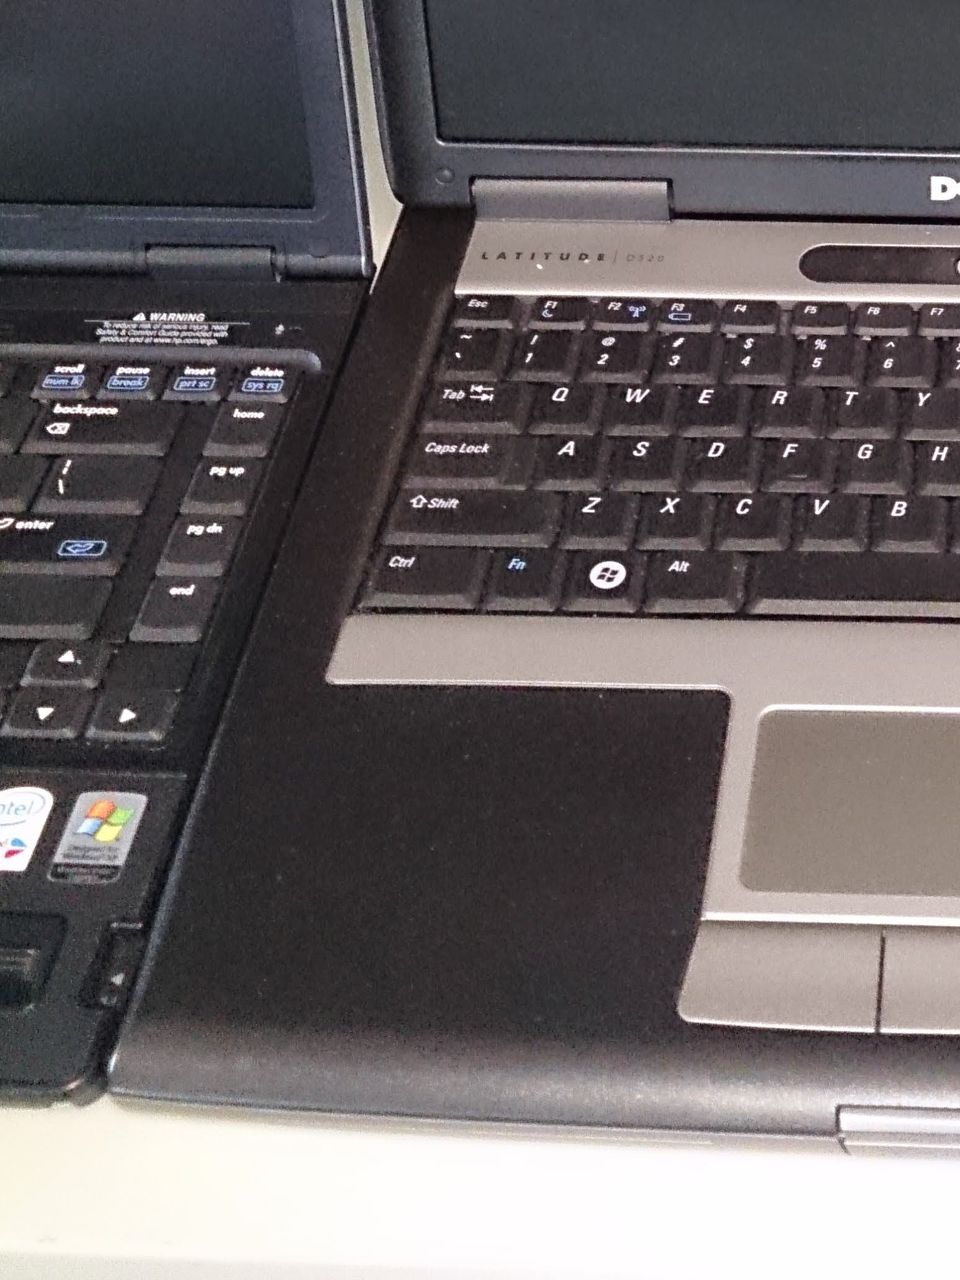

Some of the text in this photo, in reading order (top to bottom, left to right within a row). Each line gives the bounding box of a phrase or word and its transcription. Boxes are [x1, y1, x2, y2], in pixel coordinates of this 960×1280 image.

[482, 252, 604, 262] LATITUDE
[468, 299, 488, 307] Esc
[608, 302, 622, 310] F2
[671, 303, 685, 311] F3
[867, 307, 880, 315] F6
[150, 313, 206, 321] WARNING
[744, 338, 754, 349] $
[815, 339, 826, 350] %
[526, 353, 533, 363] 1
[597, 354, 608, 364] 2
[669, 355, 680, 366] 3
[741, 356, 751, 366] 4
[812, 358, 822, 367] 5
[884, 359, 893, 368] 6
[54, 364, 85, 373] scroll
[116, 366, 150, 375] pause
[184, 366, 216, 376] insert
[250, 366, 284, 377] delete
[112, 378, 145, 386] break
[443, 389, 465, 400] Tab
[552, 387, 568, 401] Q
[626, 388, 650, 402] W
[698, 390, 714, 403] E
[772, 391, 787, 404] R
[846, 391, 858, 405] T
[919, 393, 931, 406] Y
[53, 404, 118, 416] backspace
[233, 408, 264, 419] home
[425, 442, 489, 456] Caps Lock
[558, 441, 575, 455] A
[633, 442, 649, 456] S
[708, 443, 724, 457] D
[783, 444, 798, 457] F
[858, 444, 873, 459] G
[932, 446, 948, 461] H
[209, 466, 245, 476] pg up
[428, 498, 459, 509] Shift
[582, 497, 601, 513] Z
[660, 498, 680, 513] X
[736, 499, 752, 514] C
[815, 499, 829, 515] V
[891, 501, 907, 516] B
[16, 520, 55, 530] enter
[186, 523, 223, 535] pg dn
[389, 556, 415, 568] Ctrl
[508, 559, 526, 570] Fn
[669, 560, 690, 572] Alt
[169, 584, 195, 595] end
